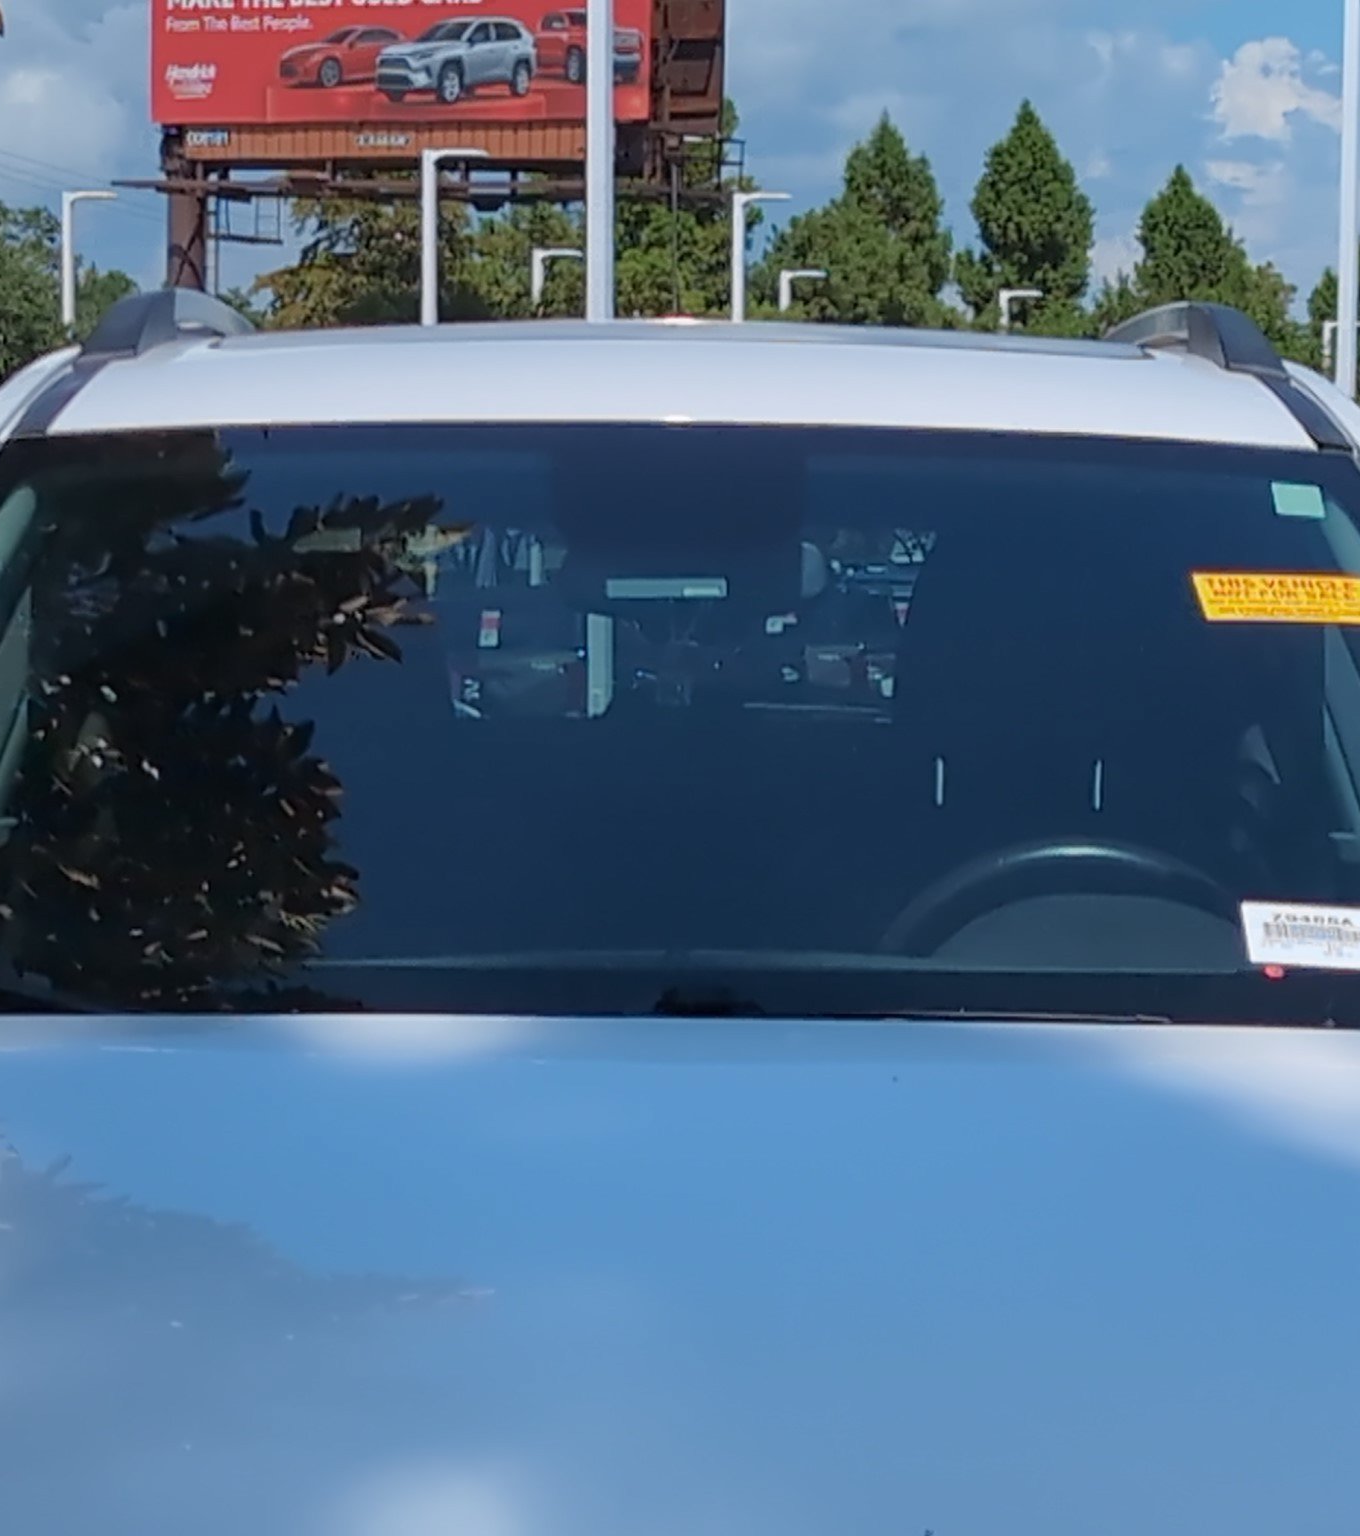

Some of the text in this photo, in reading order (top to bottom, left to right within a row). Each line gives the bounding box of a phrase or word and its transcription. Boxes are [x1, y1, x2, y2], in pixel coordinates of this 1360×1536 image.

[1206, 577, 1355, 591] THIS VEHICLE
[1258, 589, 1299, 598] FOR
